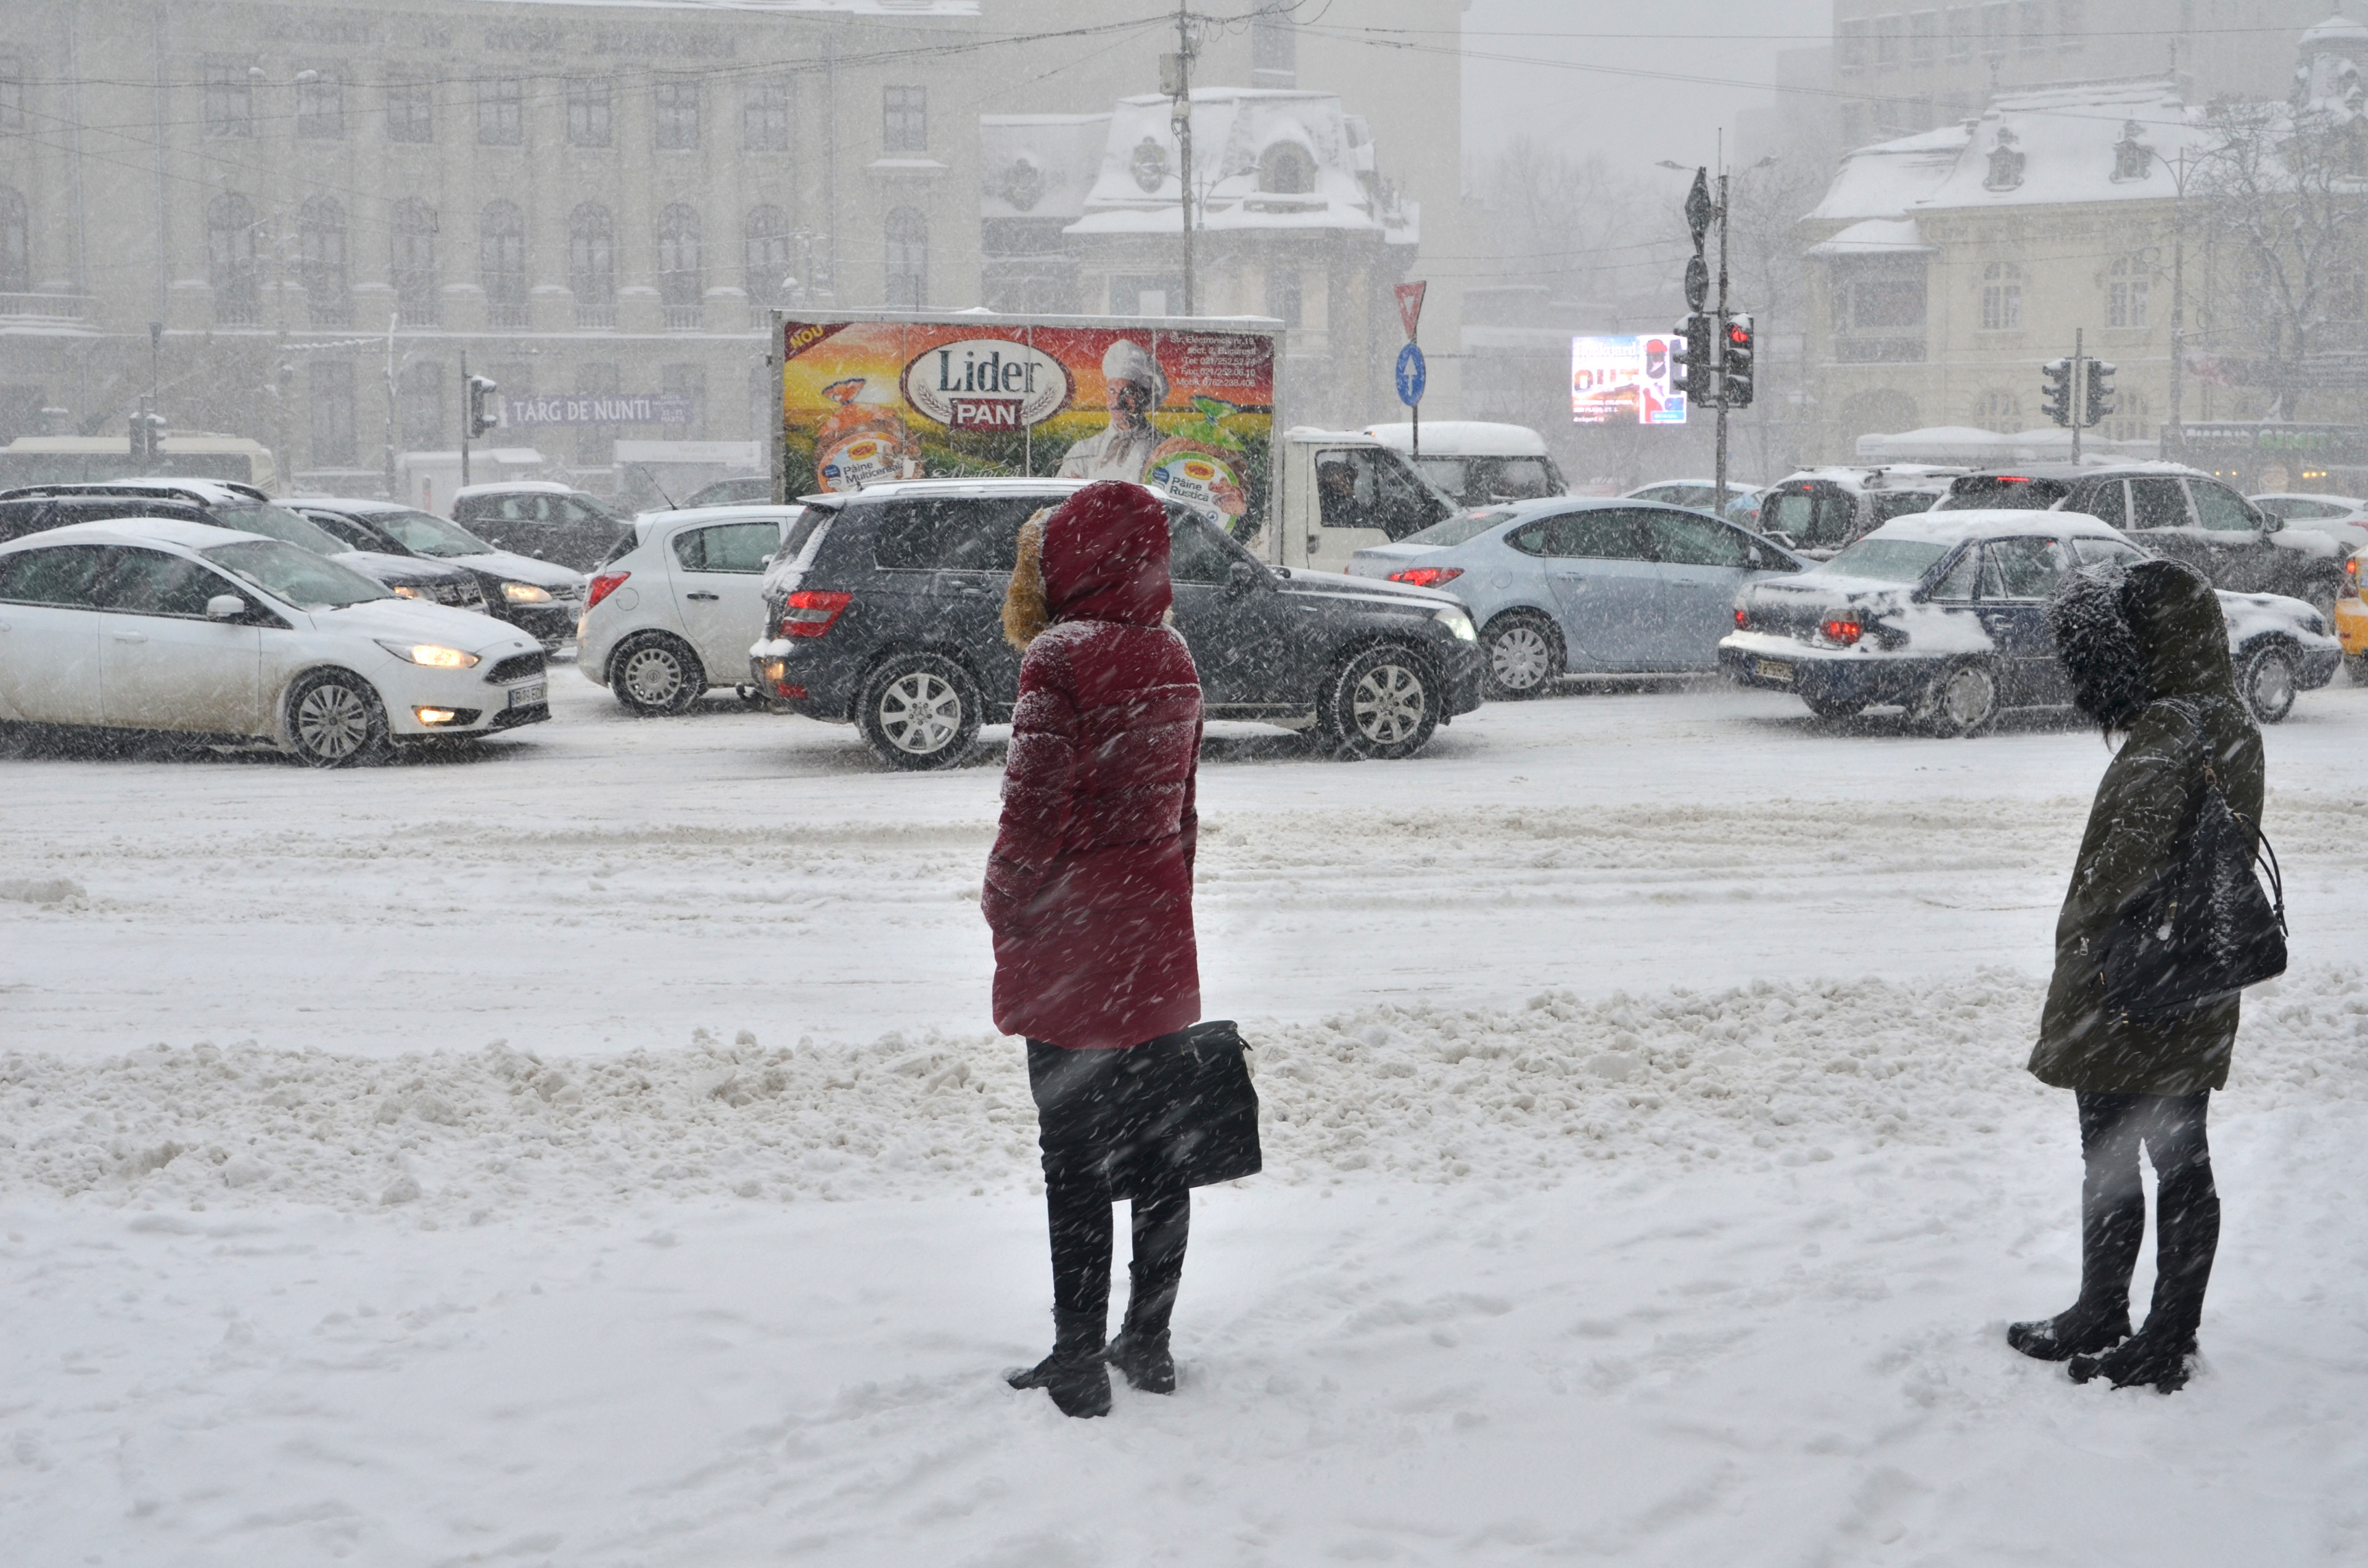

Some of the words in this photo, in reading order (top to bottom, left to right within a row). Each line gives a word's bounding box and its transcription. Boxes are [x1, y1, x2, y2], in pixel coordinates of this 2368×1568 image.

[790, 324, 824, 349] NOU
[937, 350, 1043, 393] Lider
[513, 401, 561, 421] TARG
[567, 401, 589, 420] DE
[594, 400, 650, 419] NUNTI
[957, 404, 1016, 425] PAN
[843, 462, 873, 475] Pâine
[1170, 486, 1209, 502] Rustică
[1172, 477, 1202, 491] Pâine
